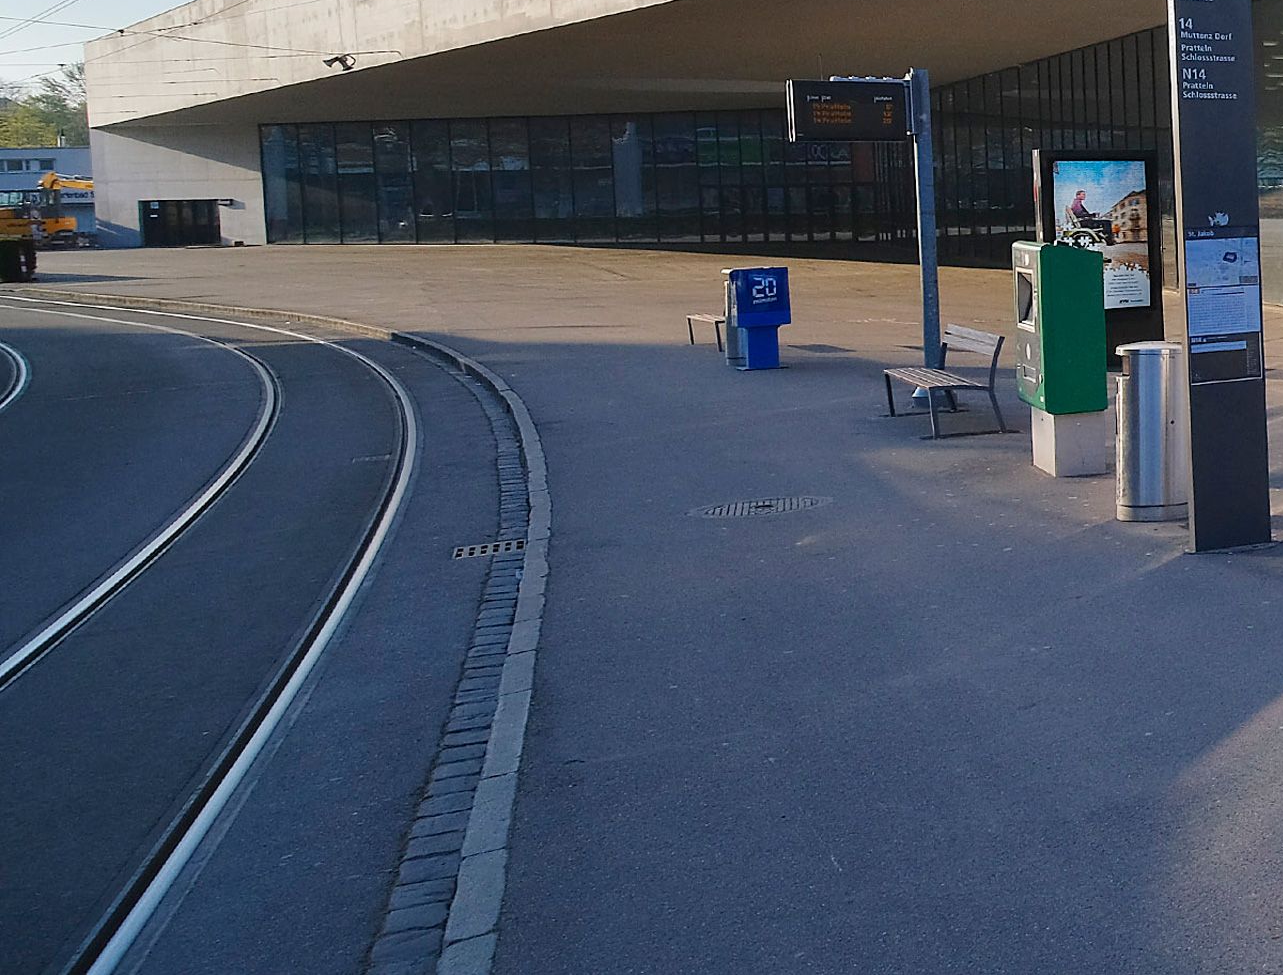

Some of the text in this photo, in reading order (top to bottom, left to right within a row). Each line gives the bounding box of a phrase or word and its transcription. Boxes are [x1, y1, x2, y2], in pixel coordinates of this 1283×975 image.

[1179, 17, 1193, 30] 14
[1180, 31, 1232, 40] Muttenz Dorf
[1181, 44, 1212, 52] Pratteln
[1181, 53, 1236, 62] Schlossstrasse
[1182, 68, 1207, 80] N14
[1182, 81, 1214, 90] Pratteln
[1182, 91, 1238, 100] Schlossstrasse
[752, 277, 777, 297] 20
